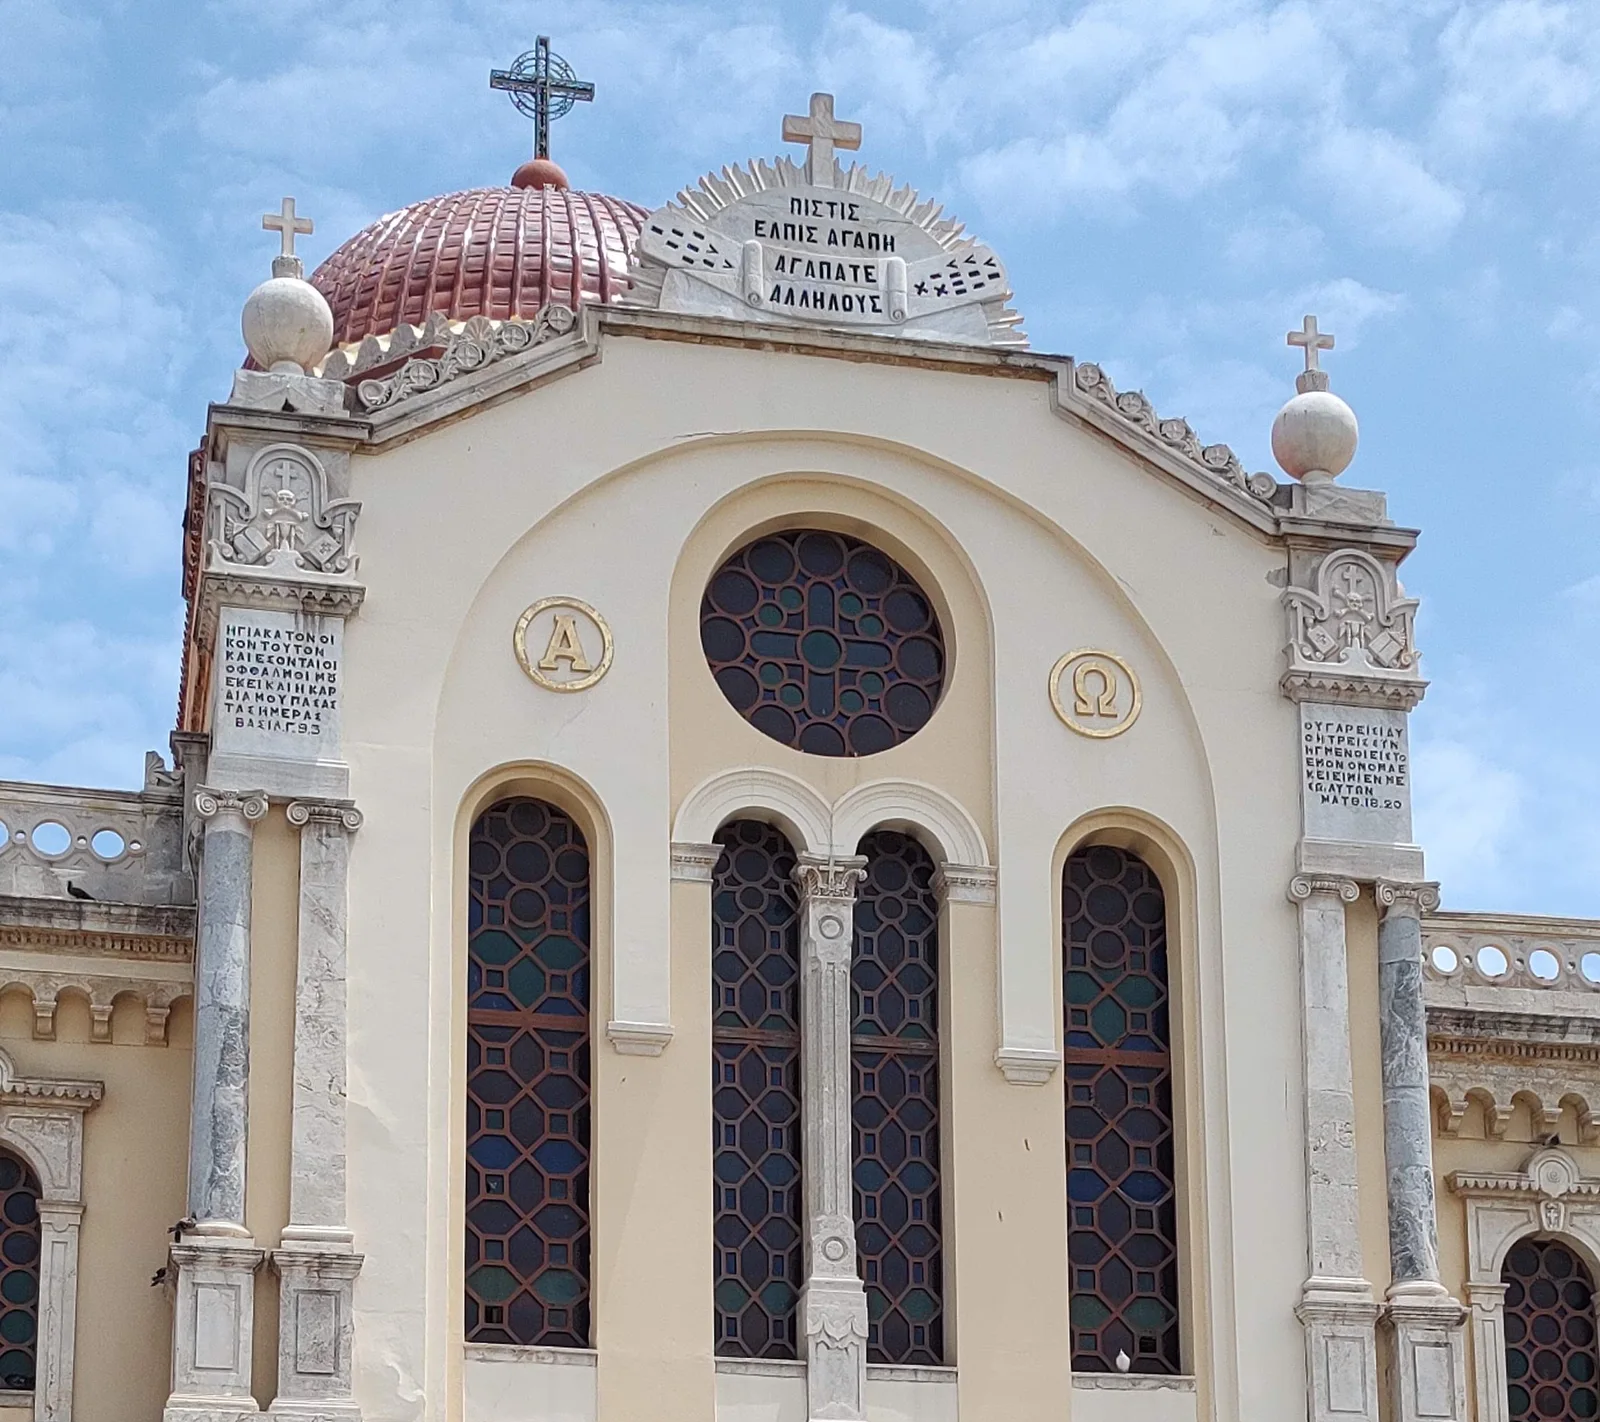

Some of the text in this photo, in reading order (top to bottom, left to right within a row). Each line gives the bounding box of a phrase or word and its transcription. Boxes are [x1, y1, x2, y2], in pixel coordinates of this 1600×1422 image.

[790, 196, 860, 222] ΠΙΣΤΙΣ
[754, 219, 895, 253] ΕΛΠΙΣ ΑΓΑΠΗ
[774, 254, 878, 285] ΑΓΑΠΑΤΕ
[769, 283, 883, 314] ΑΛΛΗΛΟΥΣ
[226, 637, 325, 657] ΚΟΝ ΤΟΥΤΟΝ
[285, 630, 315, 643] ΤΟΝ
[320, 634, 335, 645] ΟΙ
[226, 650, 251, 662] ΚΑΙ
[256, 653, 320, 670] ΕΣΟΝΤΑΙ
[225, 664, 309, 681] ΟΦΘΑΛΜΟΙ
[226, 676, 261, 689] ΕΚΕΙ
[225, 689, 337, 709] ΔΙΑ ΜΟΥ ΠΑΣΑΣ
[1073, 662, 1119, 718] Ω
[224, 703, 322, 721] ΤΑΣ ΗΜΕΡΑΣ
[1305, 757, 1344, 770] ΕΜΟΝ
